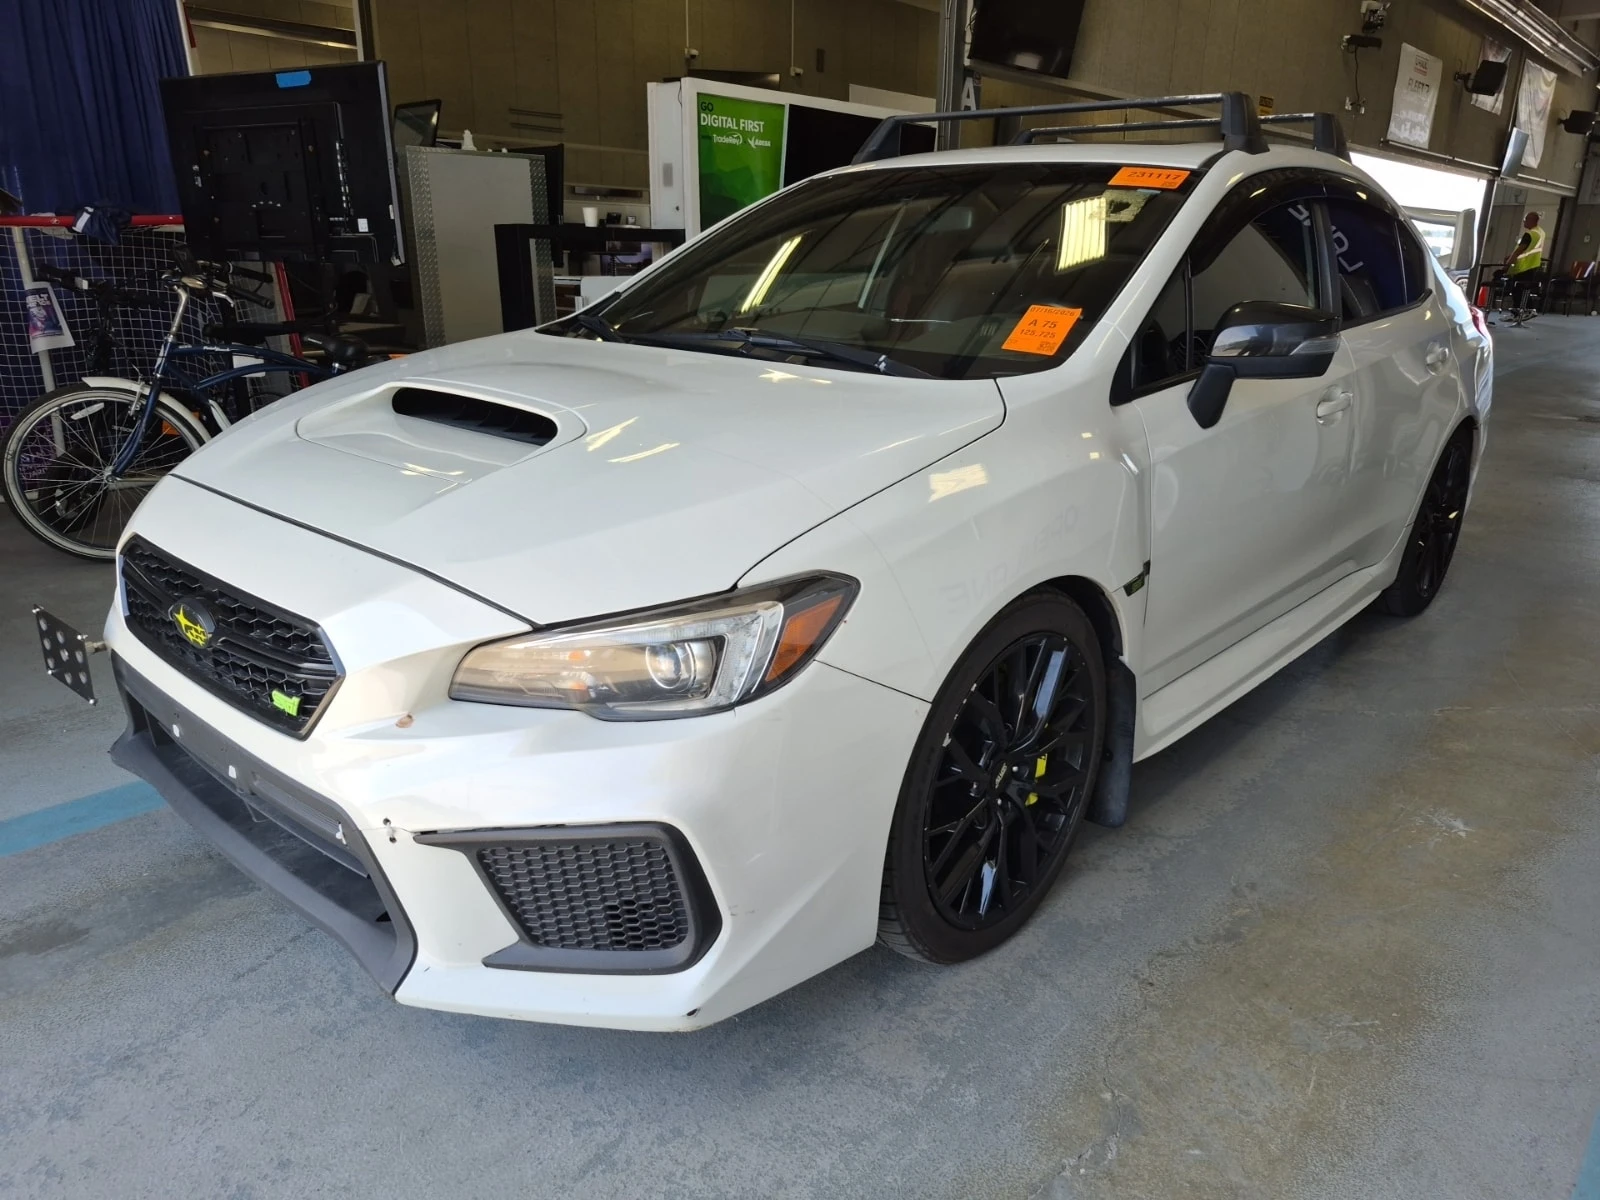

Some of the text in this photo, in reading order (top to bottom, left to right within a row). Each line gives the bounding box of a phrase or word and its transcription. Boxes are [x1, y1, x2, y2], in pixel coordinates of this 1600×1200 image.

[701, 101, 714, 112] GO
[700, 113, 765, 133] DIGITAL FIRST
[1028, 319, 1058, 329] A 75
